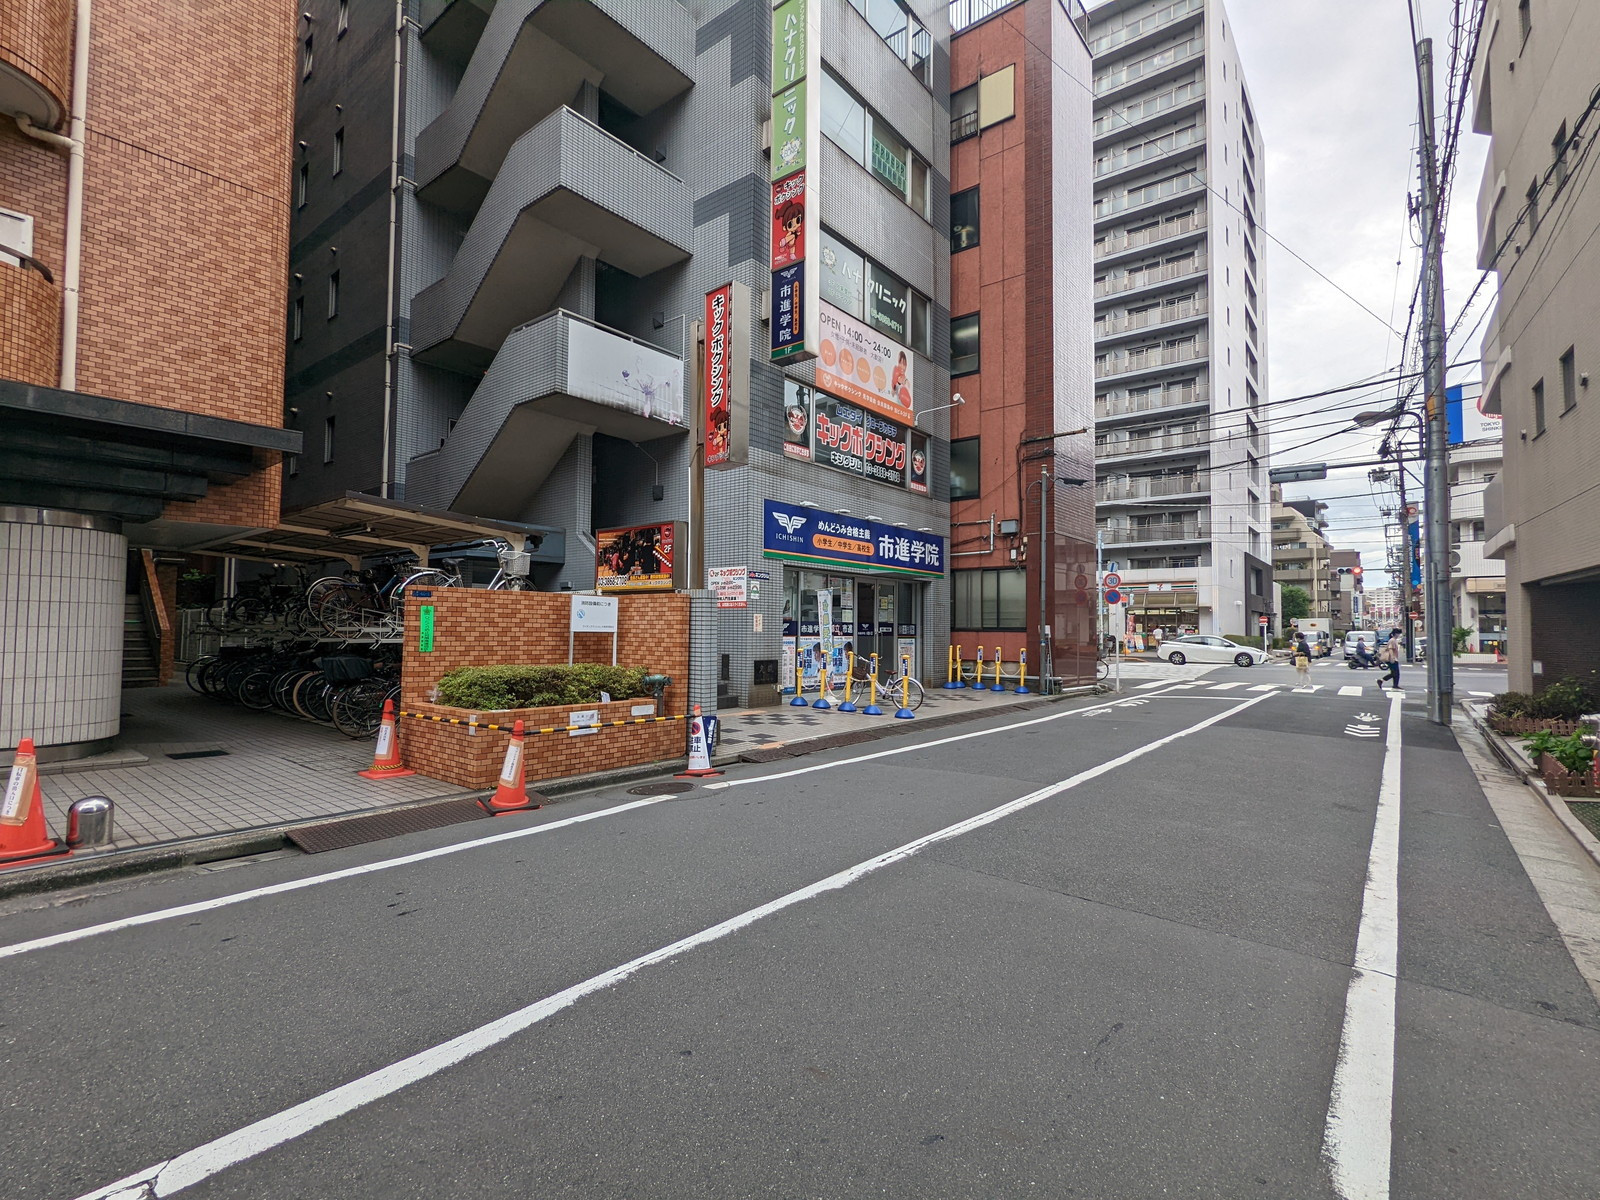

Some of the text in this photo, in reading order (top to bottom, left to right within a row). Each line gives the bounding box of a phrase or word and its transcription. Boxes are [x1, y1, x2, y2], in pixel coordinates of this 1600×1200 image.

[783, 13, 798, 135] ハナクリニック
[779, 284, 792, 342] 市進学院
[710, 294, 725, 408] キックボクシング
[784, 345, 793, 355] 1F
[820, 312, 842, 332] OPEN
[843, 324, 863, 344] 14:00
[872, 341, 893, 359] 24:00
[816, 412, 906, 470] キックボクシング
[775, 532, 804, 544] ICHISHIN
[817, 520, 871, 540] めんどうみ合格主義
[663, 543, 672, 554] 2F
[878, 534, 940, 567] 市進学院
[1107, 576, 1118, 585] 30
